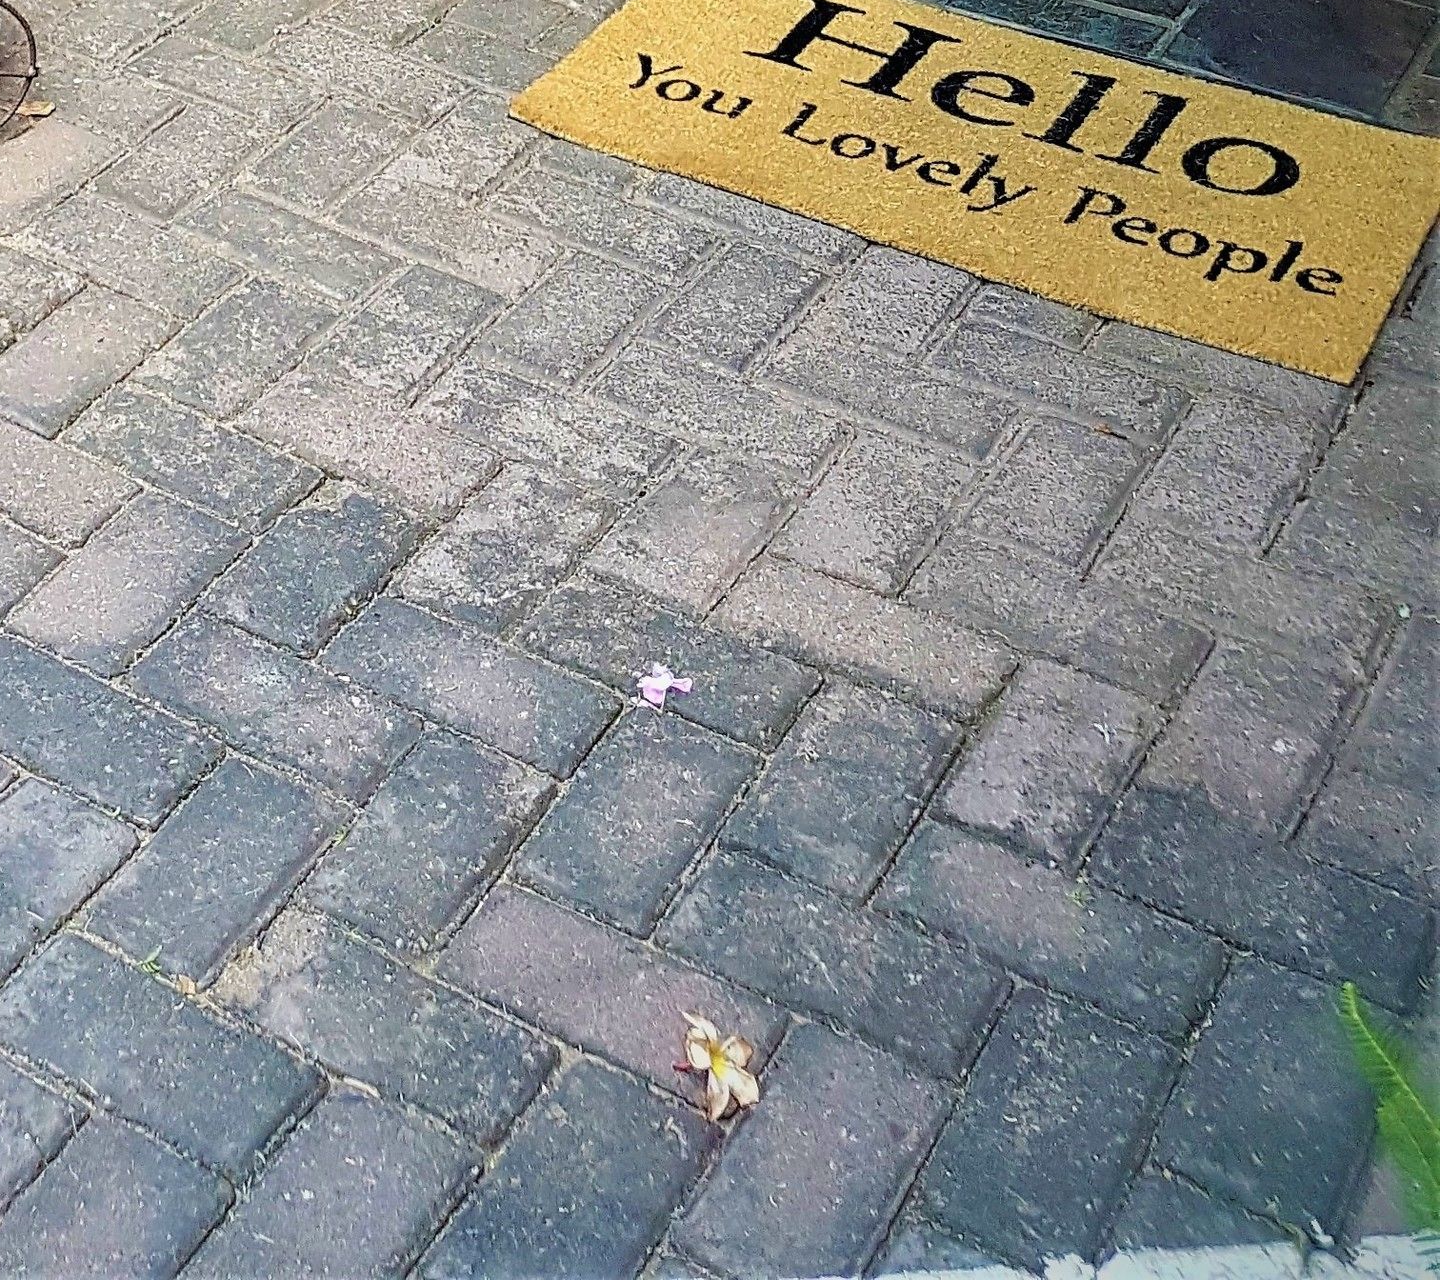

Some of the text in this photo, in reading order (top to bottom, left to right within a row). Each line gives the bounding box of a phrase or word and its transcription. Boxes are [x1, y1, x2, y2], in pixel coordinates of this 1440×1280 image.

[628, 53, 1344, 297] You Lovely People
